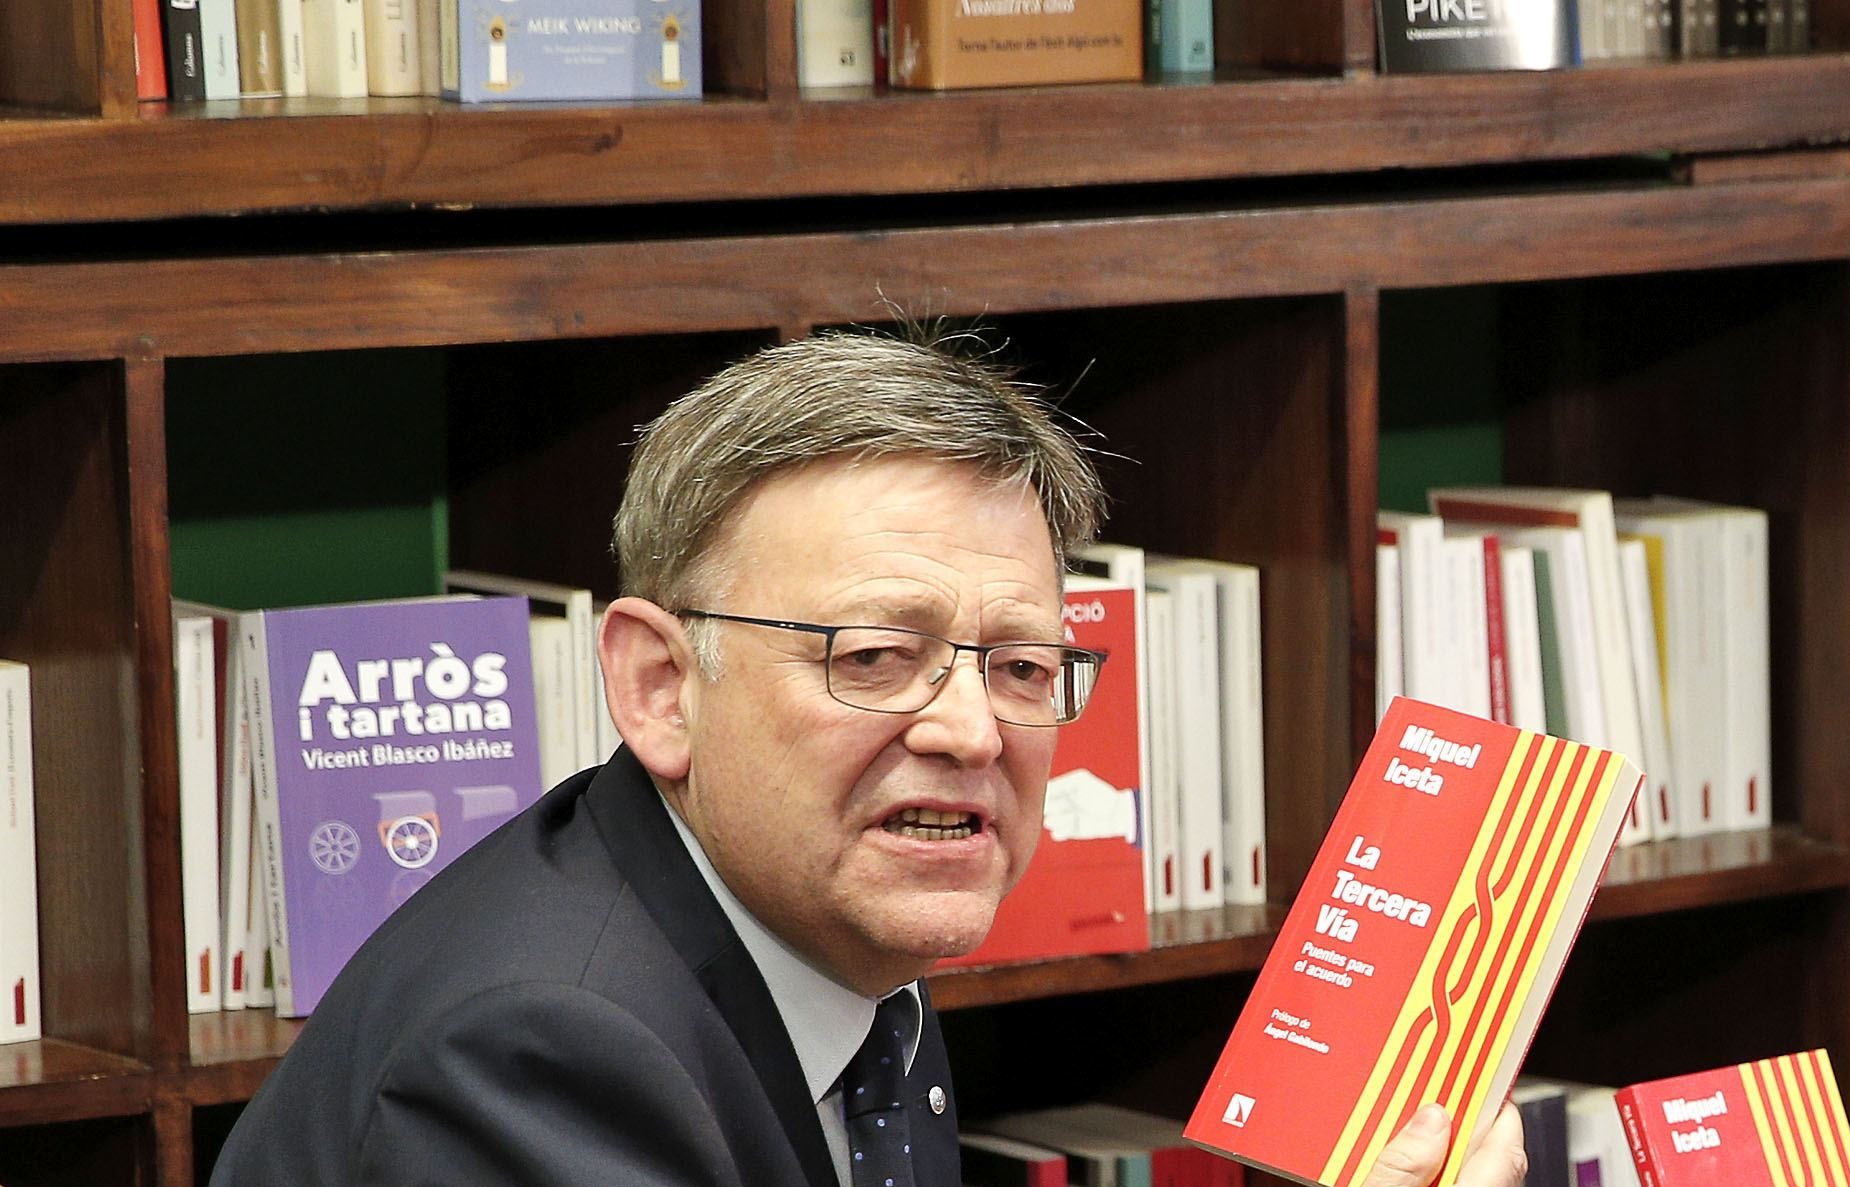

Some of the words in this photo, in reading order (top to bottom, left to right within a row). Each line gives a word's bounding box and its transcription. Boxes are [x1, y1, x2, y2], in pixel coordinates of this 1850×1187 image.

[527, 16, 569, 35] MEIK
[573, 16, 642, 35] WIKING
[299, 641, 509, 706] Arròs
[299, 706, 313, 741] i
[326, 699, 512, 740] tartana
[302, 747, 369, 770] Vicent
[371, 743, 440, 767] Blasco
[442, 737, 515, 762] Ibáñez
[1399, 724, 1482, 769] Miquel
[1383, 757, 1444, 796] Iceta
[1344, 834, 1381, 870] La
[1331, 869, 1432, 928] Tercera
[1315, 903, 1359, 942] Vía
[1293, 959, 1309, 973] el
[1306, 964, 1353, 988] acuerdo
[1301, 941, 1347, 967] Puentes
[1346, 958, 1375, 977] para
[1299, 1018, 1311, 1030] de
[1662, 1089, 1728, 1124] Miquel
[1671, 1126, 1721, 1154] Iceta
